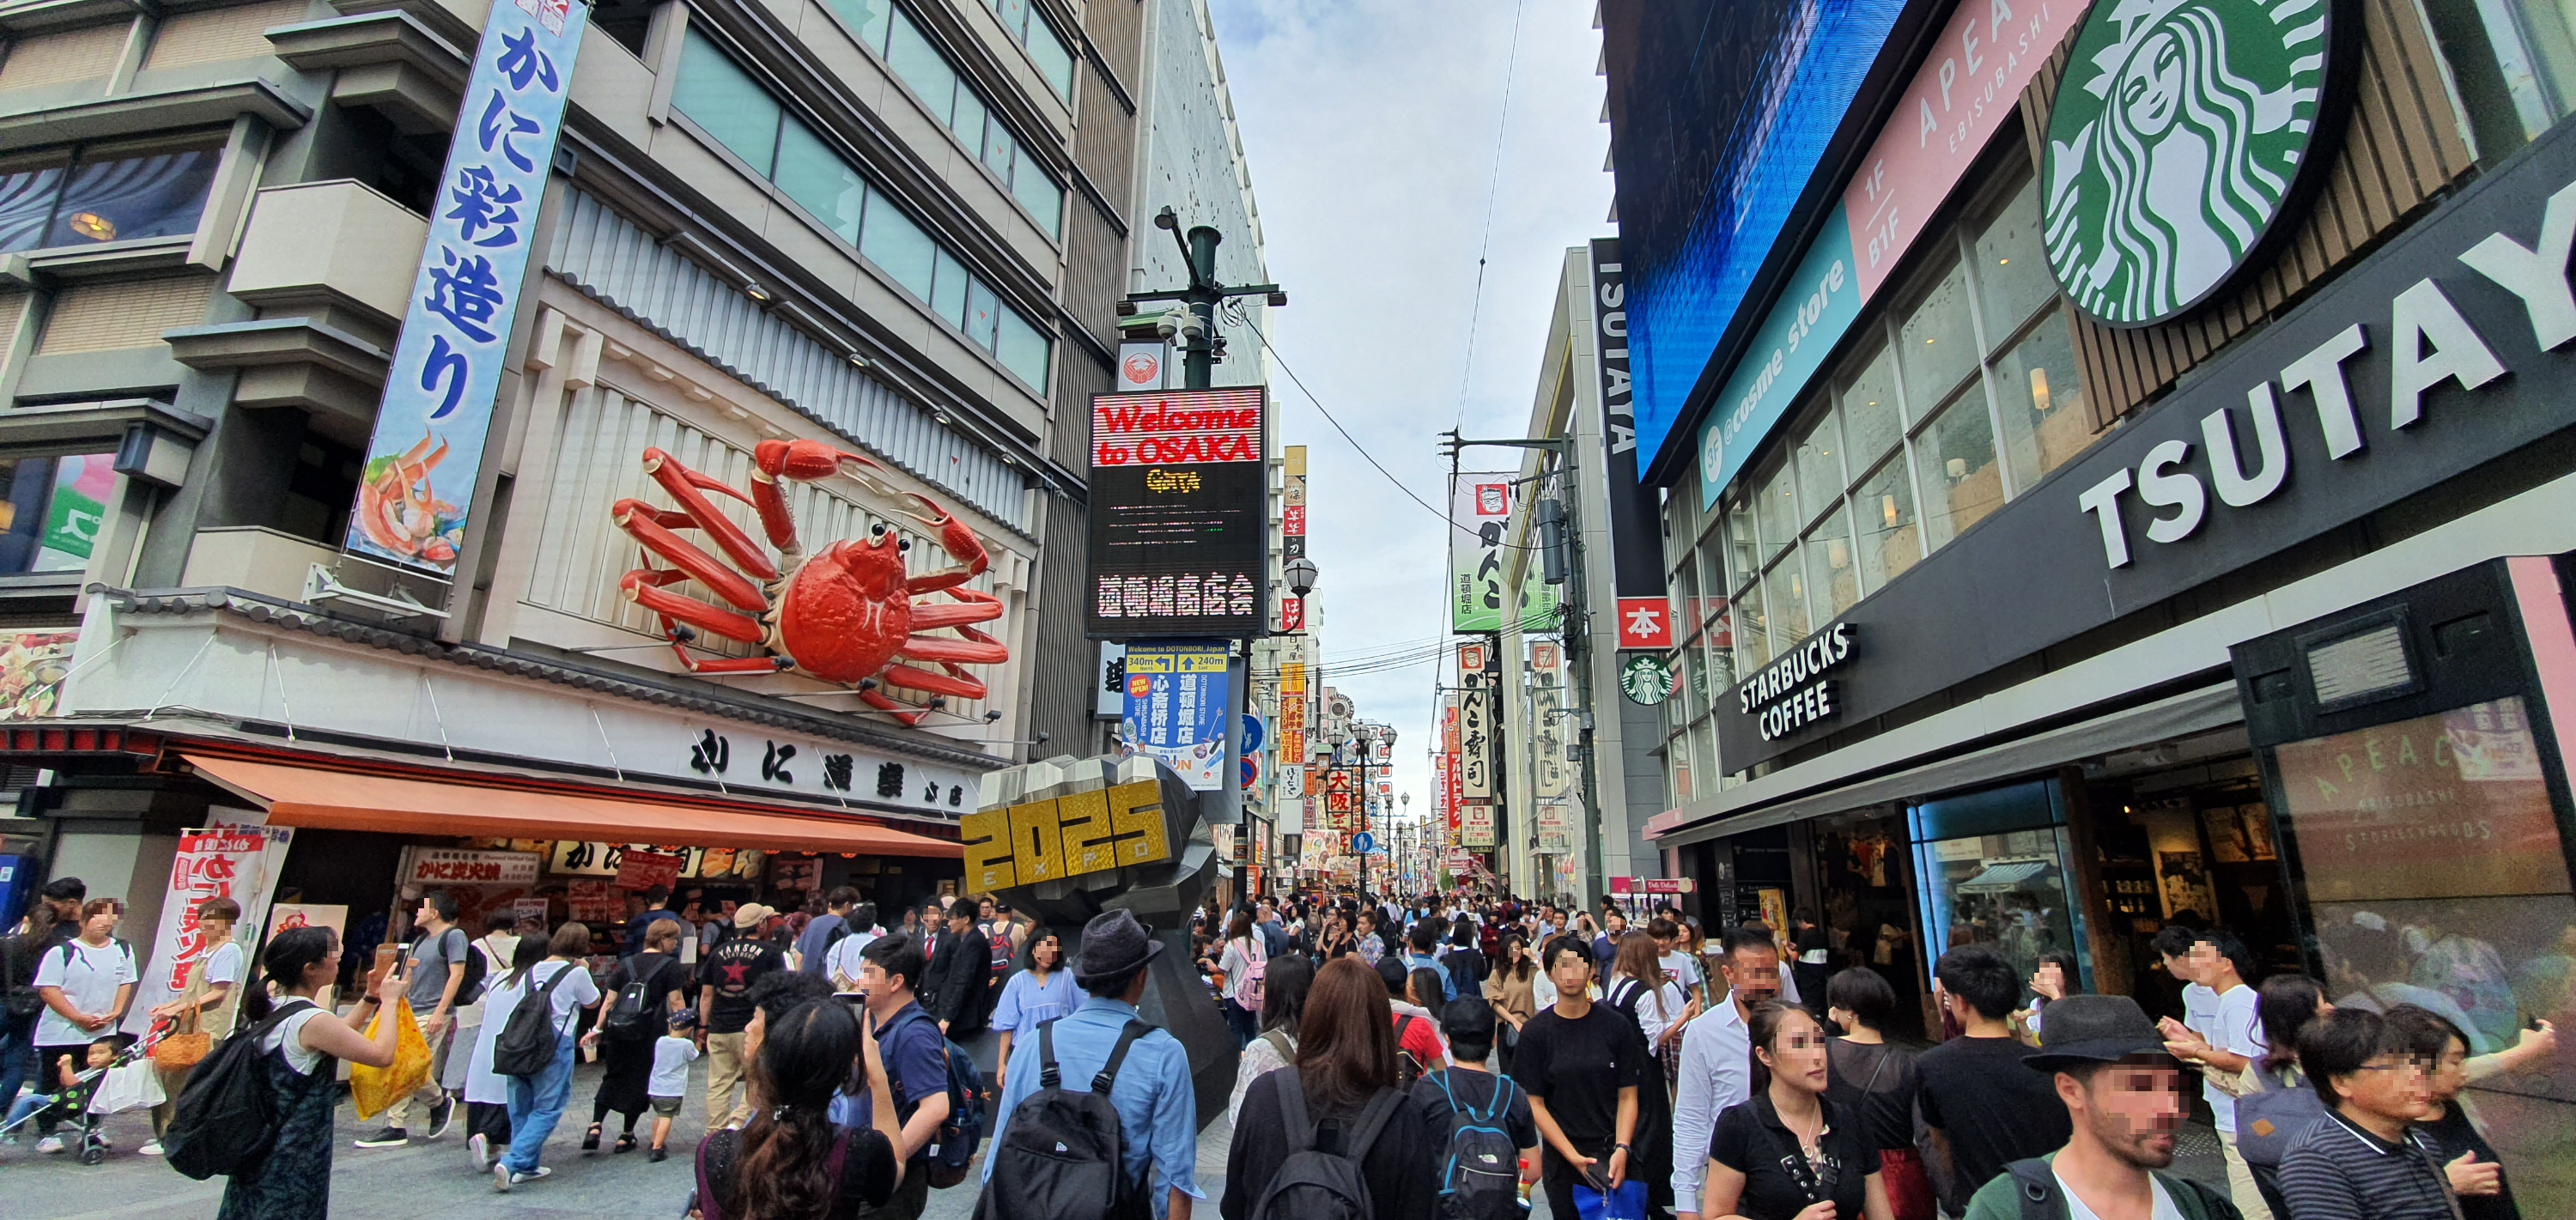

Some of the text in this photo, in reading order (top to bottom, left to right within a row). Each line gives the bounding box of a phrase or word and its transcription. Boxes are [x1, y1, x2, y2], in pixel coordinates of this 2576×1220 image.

[1948, 3, 2049, 154] EBISUBASHI
[1865, 159, 1884, 203] 1F
[421, 26, 559, 419] かに彩造り
[1868, 206, 1899, 269] B1F
[1707, 259, 1844, 469] 3F @cosme store
[1097, 401, 1257, 434] Welcome
[1097, 434, 1257, 465] to OSAKA
[1460, 574, 1472, 615] 道頓堀店
[1626, 606, 1662, 640] 本
[1132, 678, 1146, 687] NEW
[1198, 657, 1224, 665] 240m
[1740, 622, 1848, 714] STARBUCKS
[1130, 684, 1149, 694] OPEN!
[1760, 680, 1831, 742] COFFEE
[959, 780, 1168, 895] 2025
[983, 842, 1148, 886] EXPO
